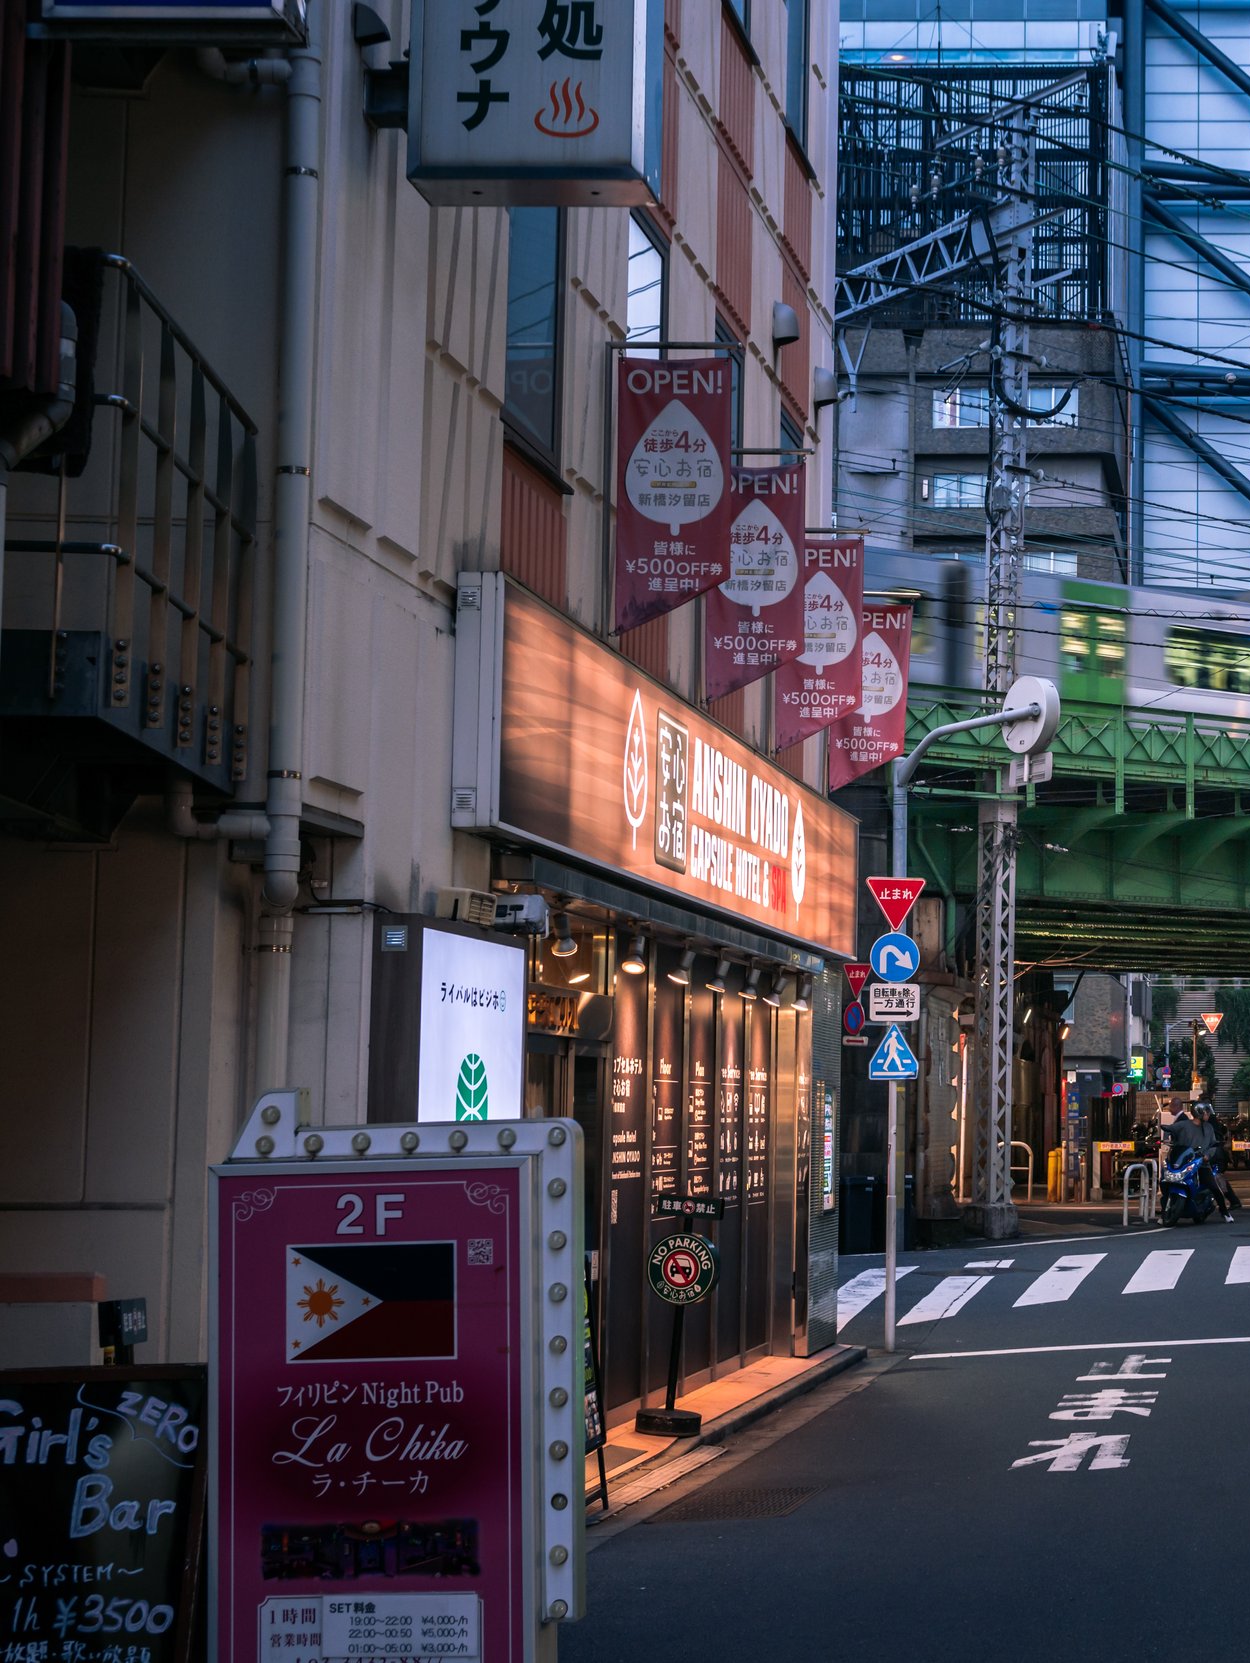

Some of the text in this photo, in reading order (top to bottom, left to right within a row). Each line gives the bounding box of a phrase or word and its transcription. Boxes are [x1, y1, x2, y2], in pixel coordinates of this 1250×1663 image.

[627, 369, 723, 394] OPEN!
[650, 429, 679, 437] ここから
[644, 430, 707, 453] 徒歩4分
[634, 458, 713, 478] 安心お宿
[638, 493, 711, 508] 新橋汐留店
[730, 525, 784, 545] 徒歩4分
[653, 541, 696, 556] 皆様に
[804, 549, 857, 567] PEN!
[625, 558, 723, 576] ¥500OFF券
[648, 577, 700, 592] 進呈中!
[724, 580, 787, 592] 新橋汐留店
[737, 621, 774, 634] 皆様に
[804, 615, 849, 632] 心お宿
[862, 613, 907, 629] PEN!
[713, 636, 797, 651] ¥500OFF券
[804, 642, 847, 653] 橋汐留店
[732, 652, 778, 666] 進呈中!
[862, 653, 893, 668] 歩4分
[803, 679, 836, 690] 皆様に
[862, 671, 896, 686] お宿
[782, 691, 856, 705] ¥500OFF券
[863, 694, 893, 705] 汐留店
[799, 706, 838, 718] 進呈中!
[853, 726, 881, 737] 皆様に
[835, 738, 899, 752] ¥500OFF券
[849, 750, 882, 762] 進呈中!
[691, 736, 789, 859] ANSHIN OYADO
[690, 825, 733, 893] CAPSULE
[735, 846, 761, 904] HOTEL
[771, 865, 787, 914] SPA
[879, 888, 914, 900] 止まれ
[849, 969, 866, 979] 止まれ
[873, 988, 915, 998] 自転車を除く
[873, 998, 916, 1008] 一方通行
[335, 1193, 407, 1236] 2F
[662, 1200, 716, 1214] 駐車 禁止
[652, 1237, 711, 1270] NO PARKING
[276, 1380, 464, 1409] フィリピン Night Pub
[1007, 1354, 1172, 1472] 止まれ
[116, 1391, 199, 1454] ZERO
[271, 1414, 469, 1468] La Chika
[312, 1470, 429, 1498] ラ・チーカ
[69, 1473, 177, 1539] Bar
[52, 1593, 175, 1638] ¥3500
[270, 1633, 322, 1648] 営業時間
